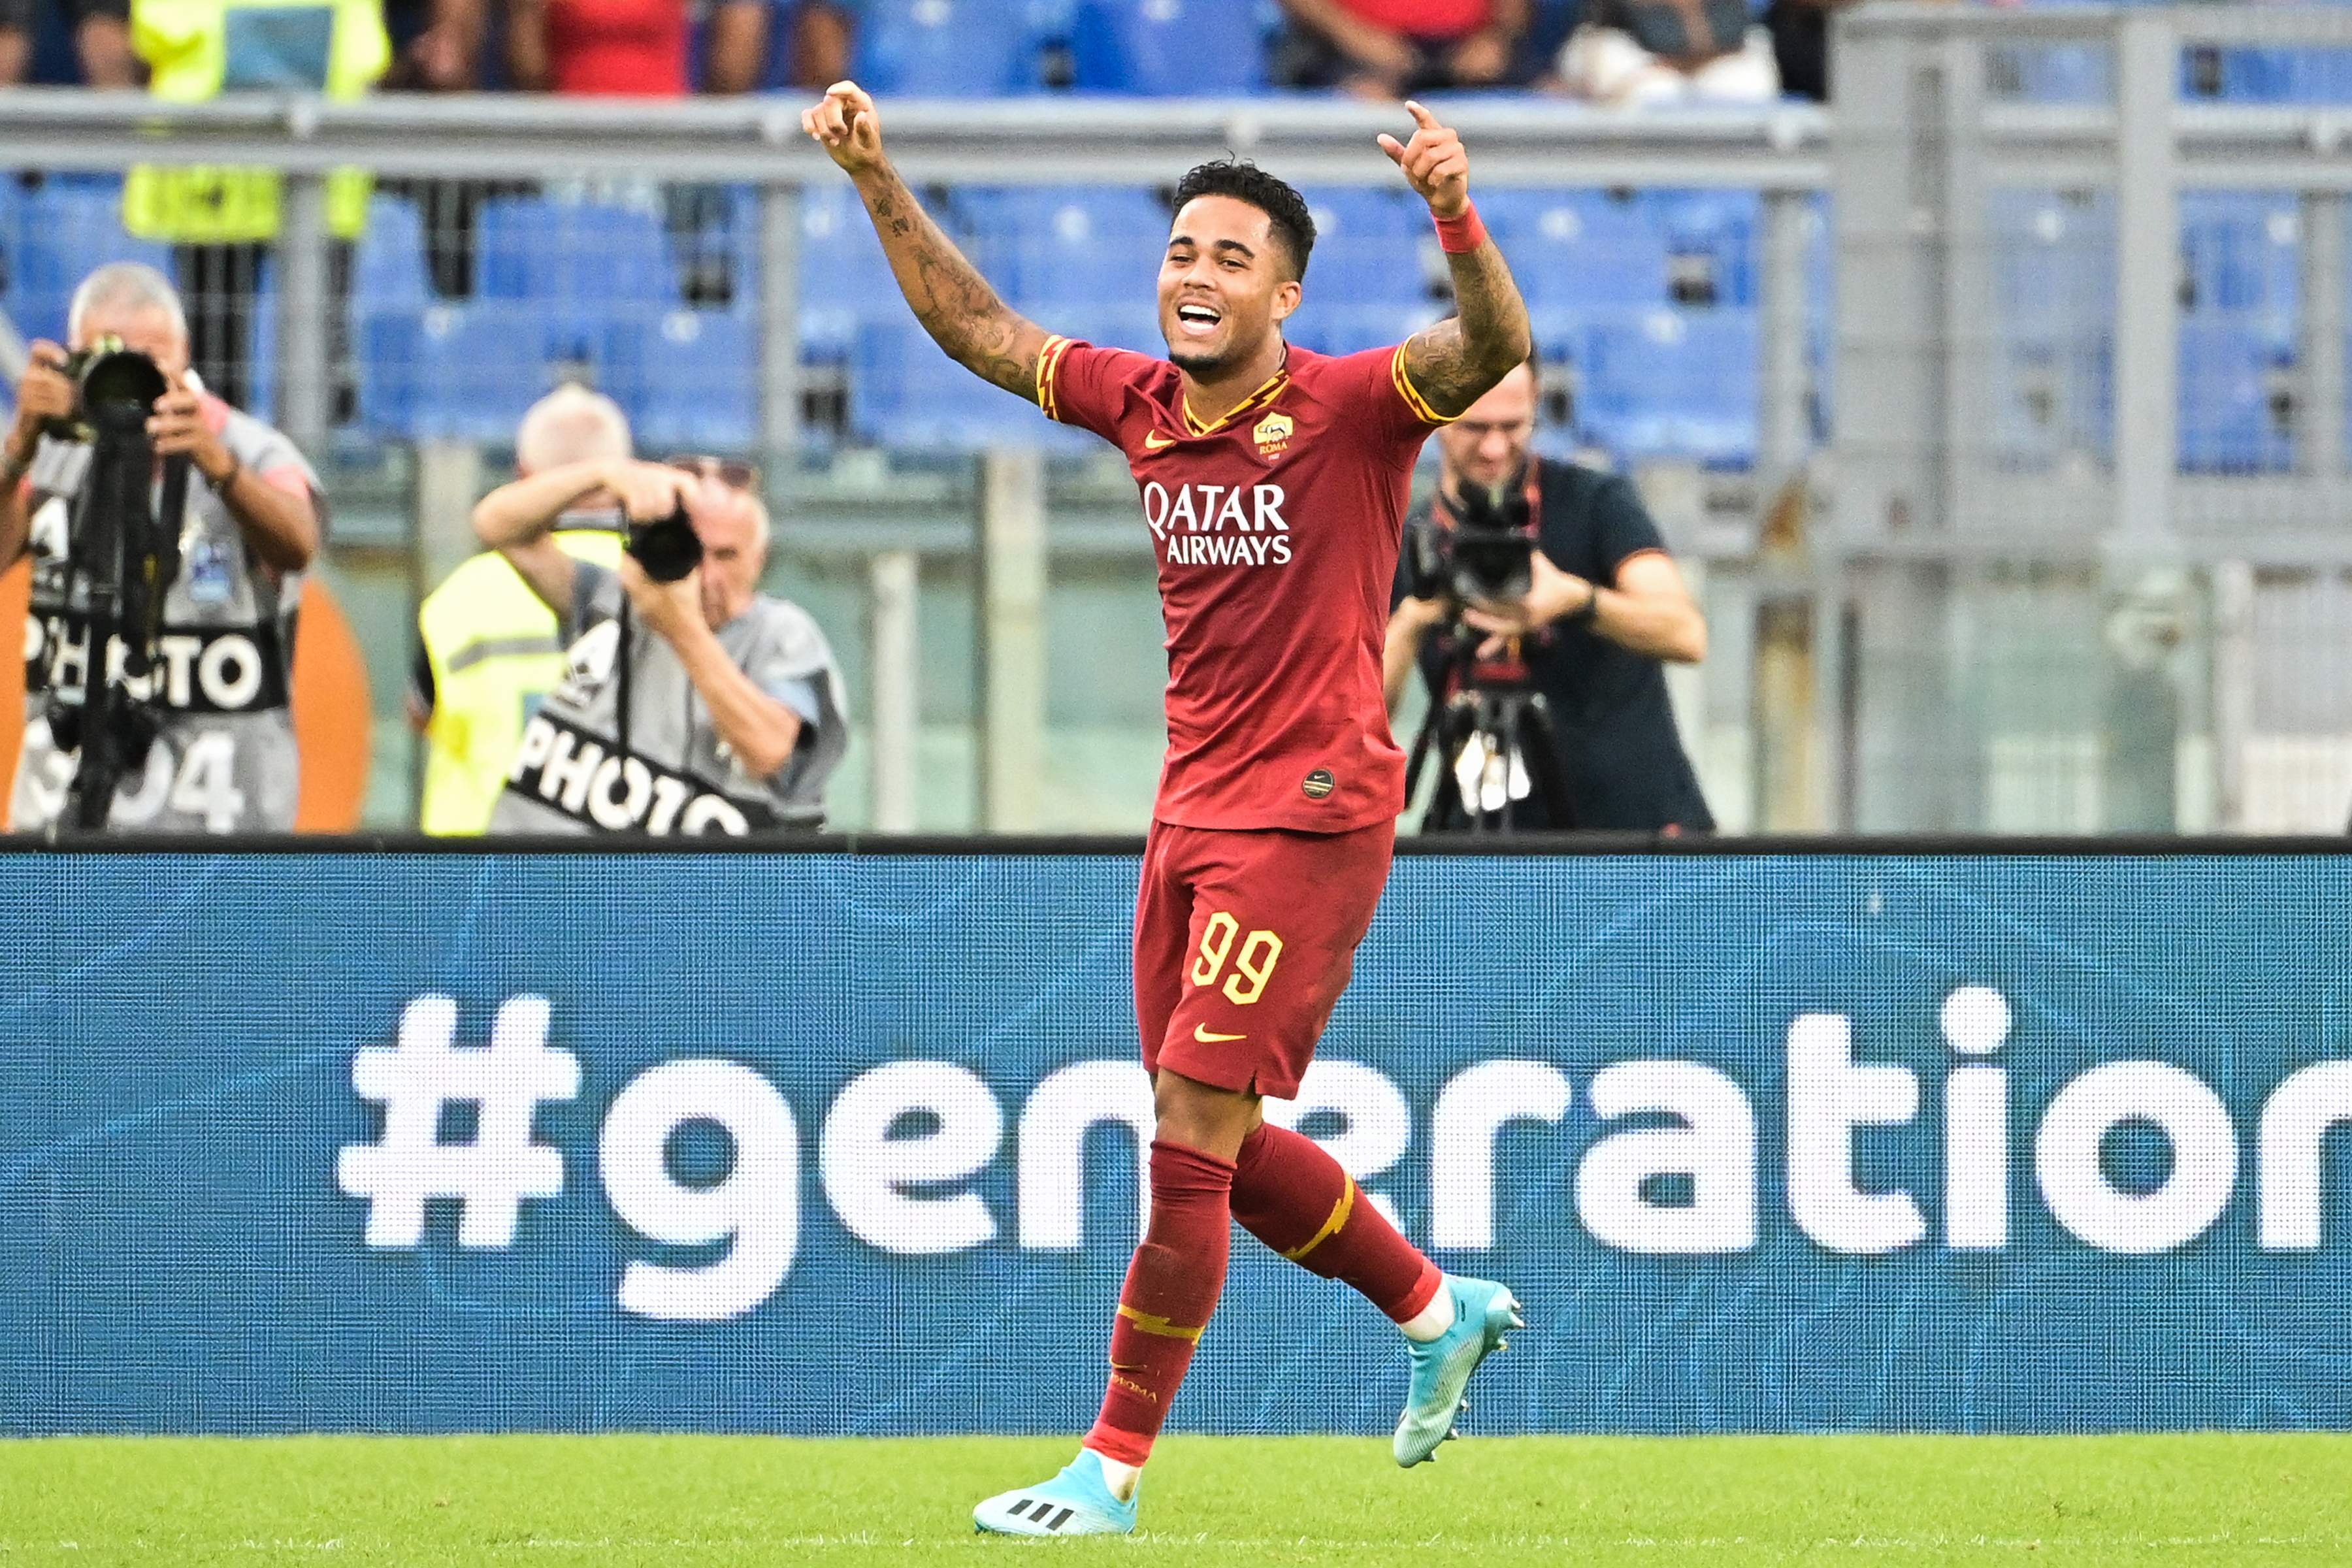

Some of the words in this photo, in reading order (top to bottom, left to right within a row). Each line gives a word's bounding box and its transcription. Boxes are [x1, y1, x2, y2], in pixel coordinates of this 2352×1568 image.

[1259, 441, 1288, 455] ROMA
[1144, 482, 1290, 541] QATAR
[1167, 534, 1292, 566] AIRWAYS
[510, 715, 749, 836] PHOTO
[1191, 911, 1283, 1005] 99
